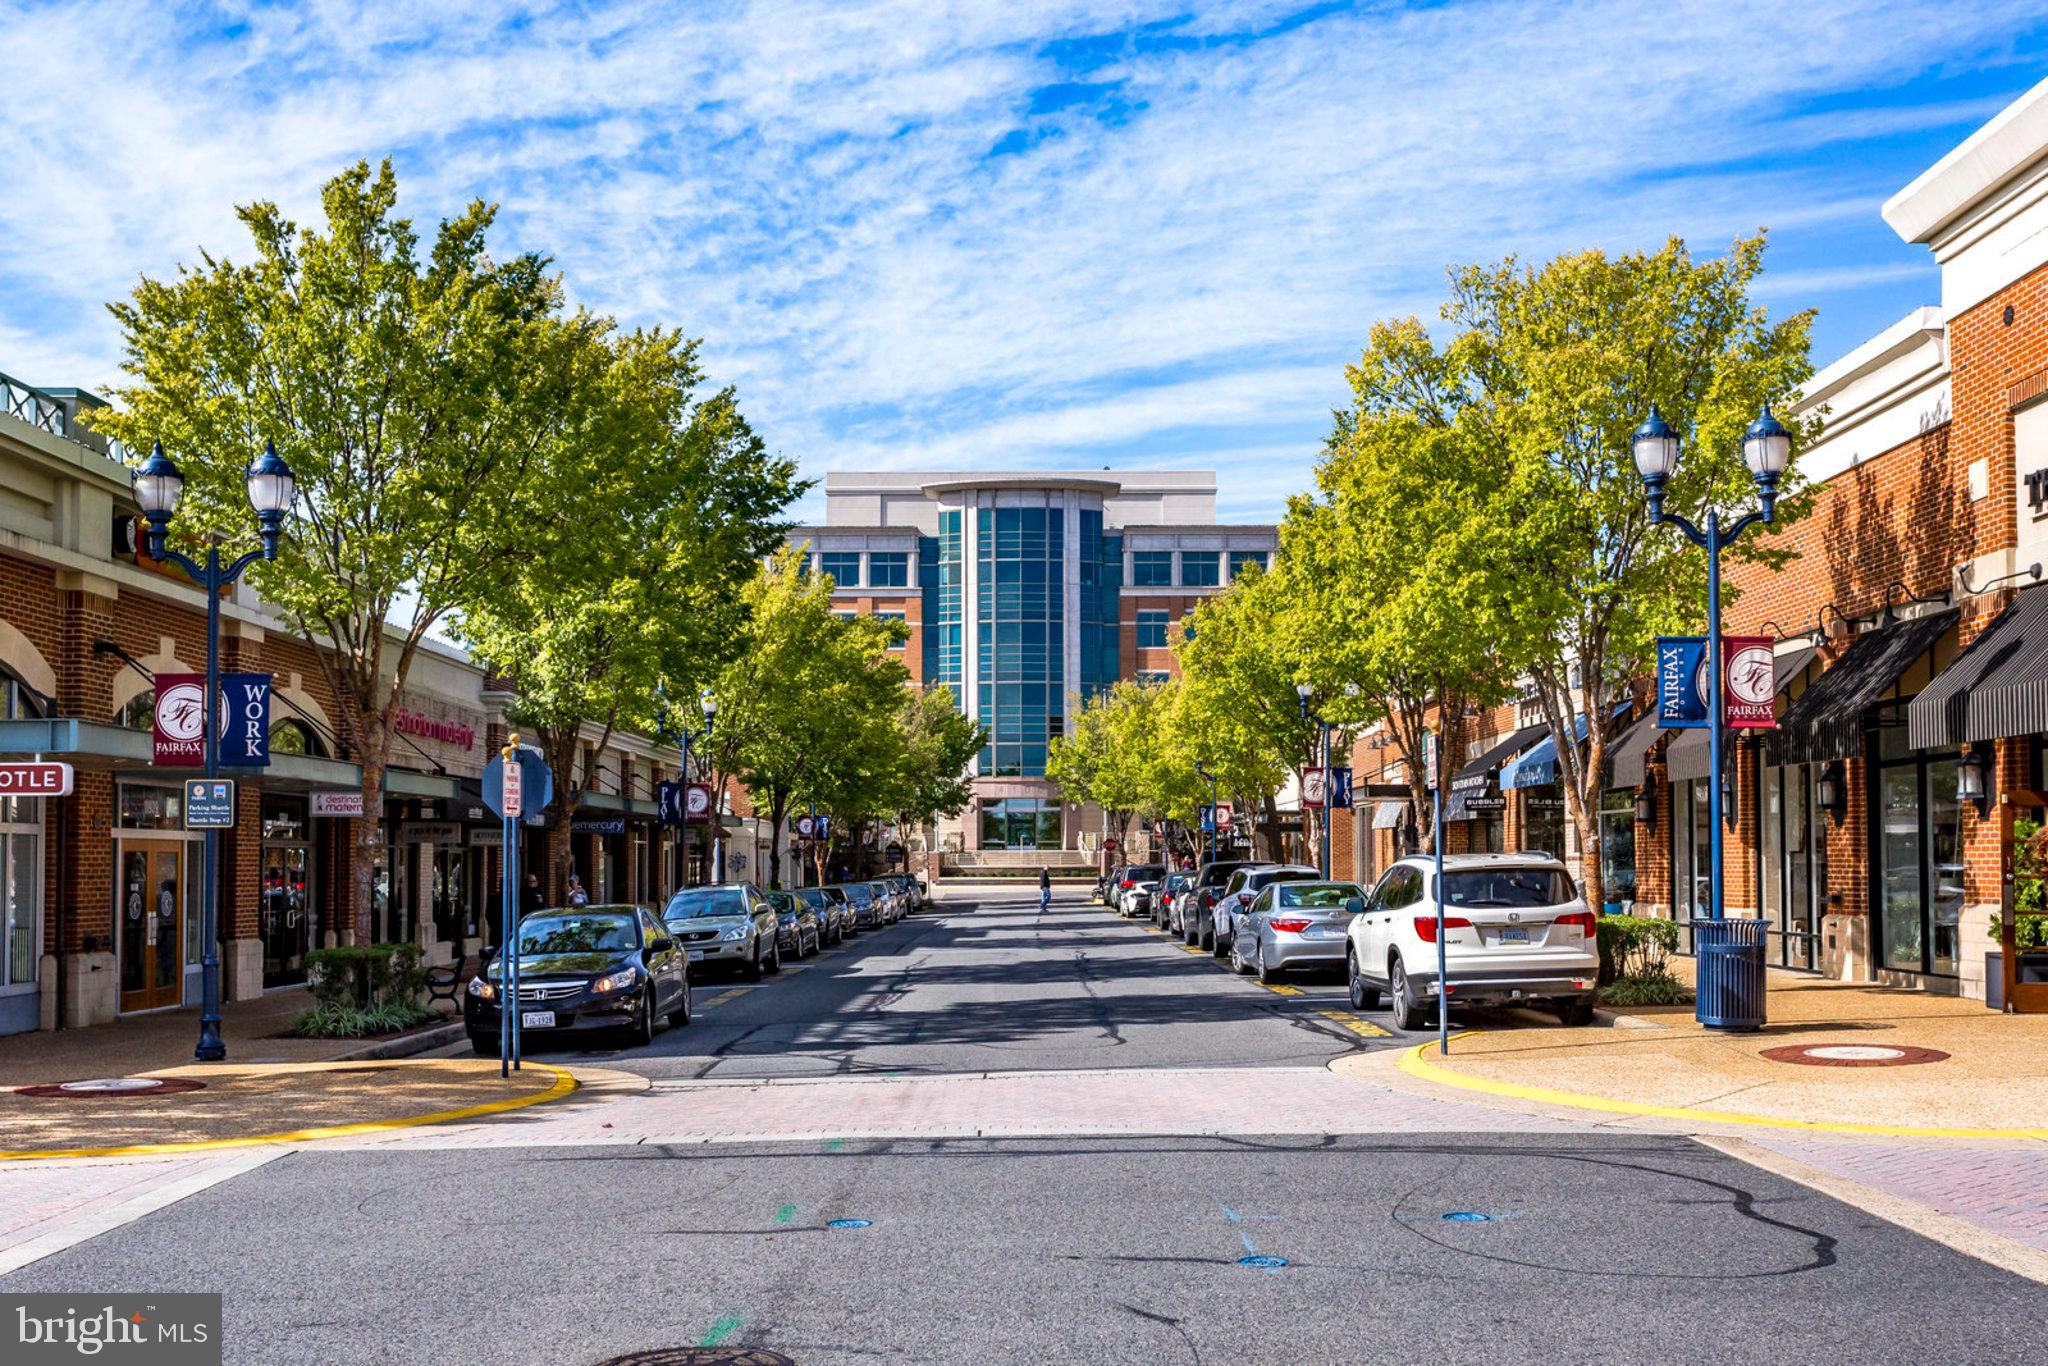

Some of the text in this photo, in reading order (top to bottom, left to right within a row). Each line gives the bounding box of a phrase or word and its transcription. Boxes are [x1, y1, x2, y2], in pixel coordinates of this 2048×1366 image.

[1664, 647, 1679, 718] FAIRFAX
[1727, 705, 1773, 715] FAIRFAX
[243, 684, 268, 756] WORK
[156, 742, 201, 752] FAIRFAX
[0, 771, 56, 787] OTLE
[1343, 771, 1351, 805] PLAY
[325, 795, 363, 804] destinat
[660, 786, 668, 820] PLAY
[325, 804, 363, 812] matern
